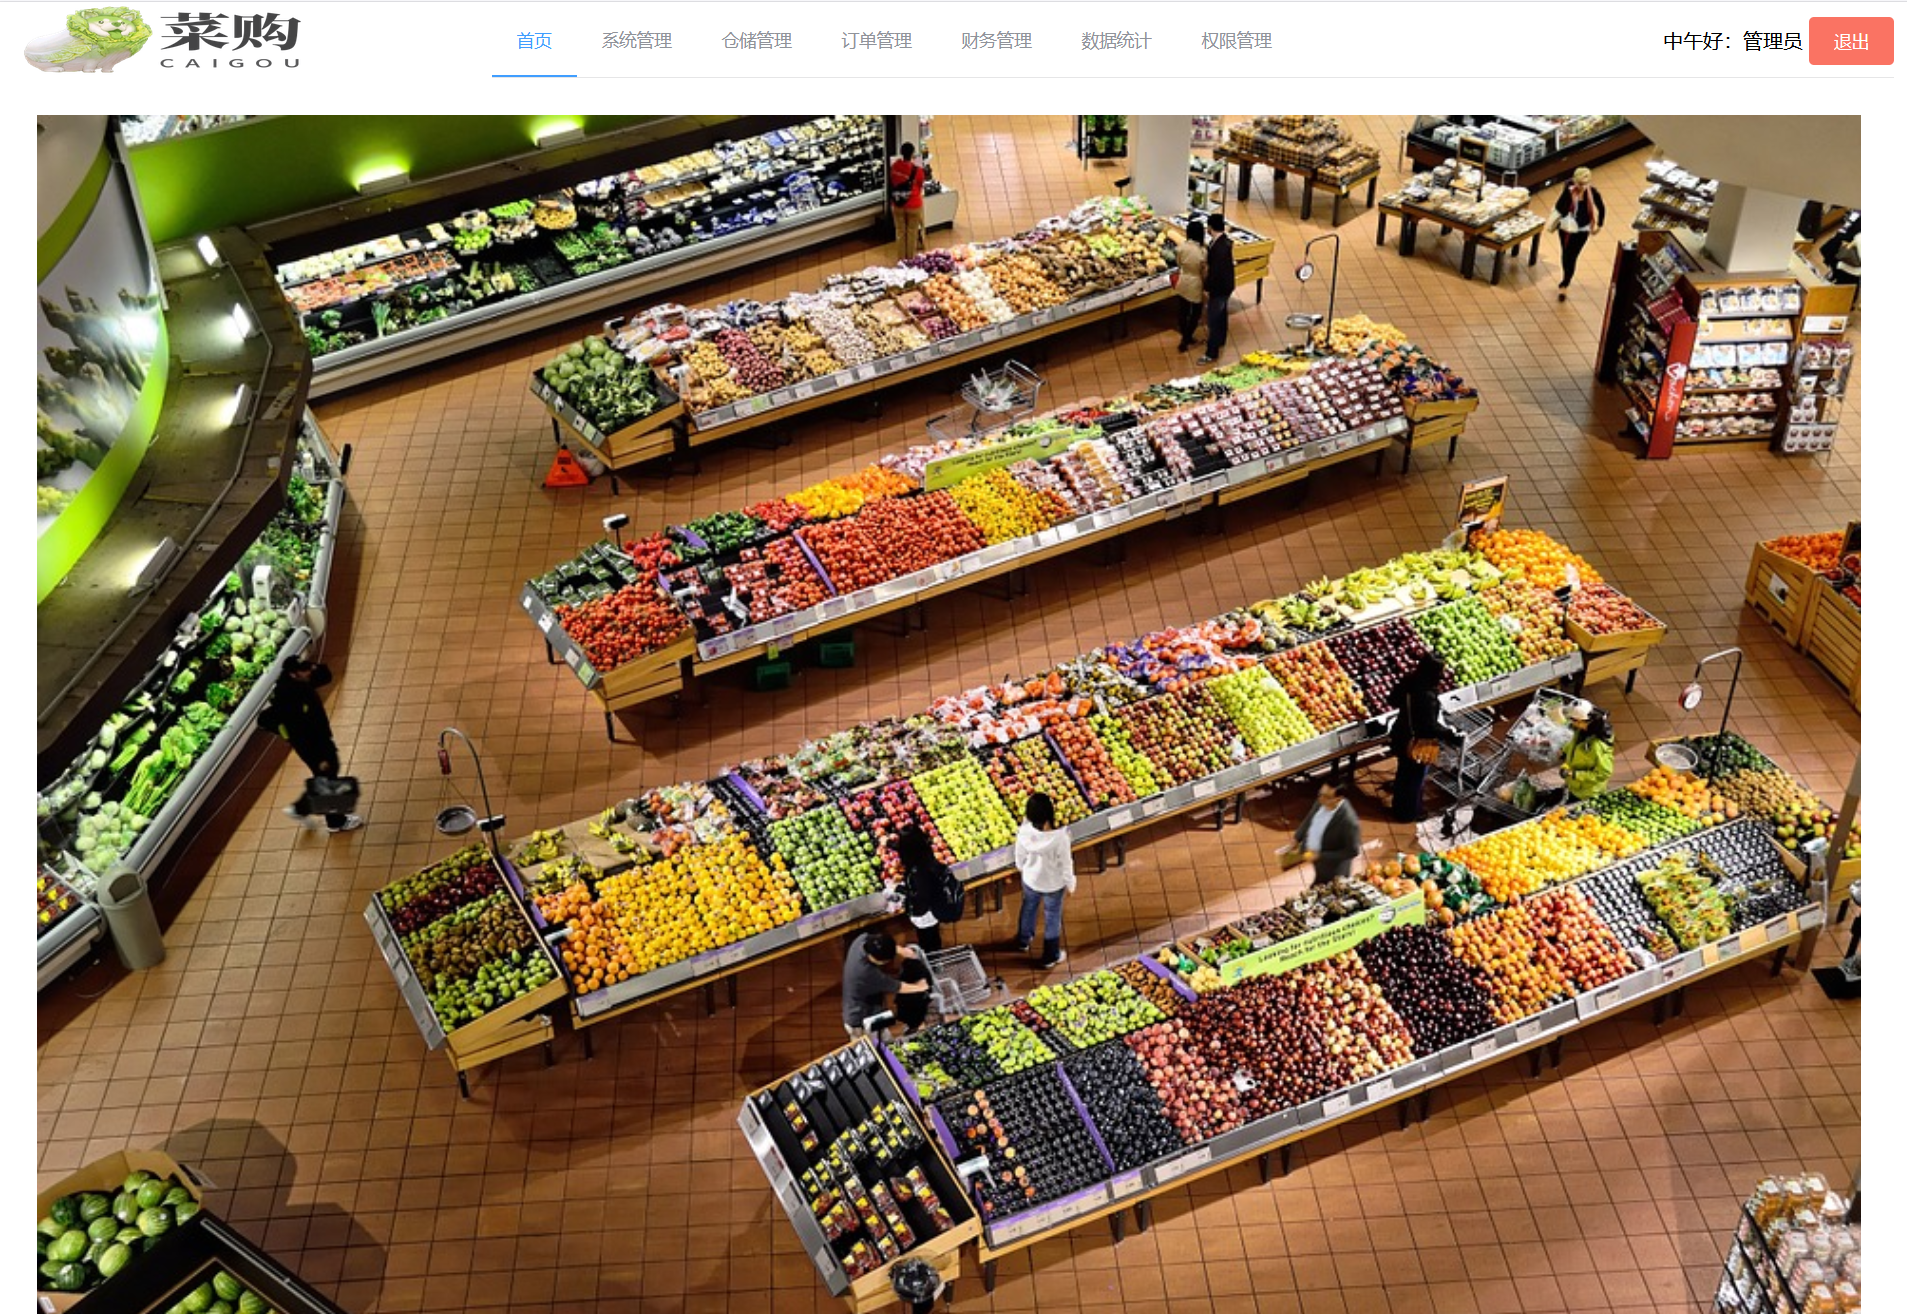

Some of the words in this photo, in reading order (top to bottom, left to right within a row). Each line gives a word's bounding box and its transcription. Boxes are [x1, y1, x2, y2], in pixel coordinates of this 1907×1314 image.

[161, 12, 301, 51] 菜购
[517, 31, 552, 50] 首页
[602, 31, 673, 50] 系统管理
[722, 31, 793, 50] 仓储管理
[841, 31, 912, 50] 订单管理
[961, 31, 1032, 50] 财务管理
[1082, 31, 1153, 50] 数据统计
[1202, 31, 1273, 50] 权限管理
[1833, 32, 1869, 51] 退出
[160, 58, 300, 69] CAIGOU
